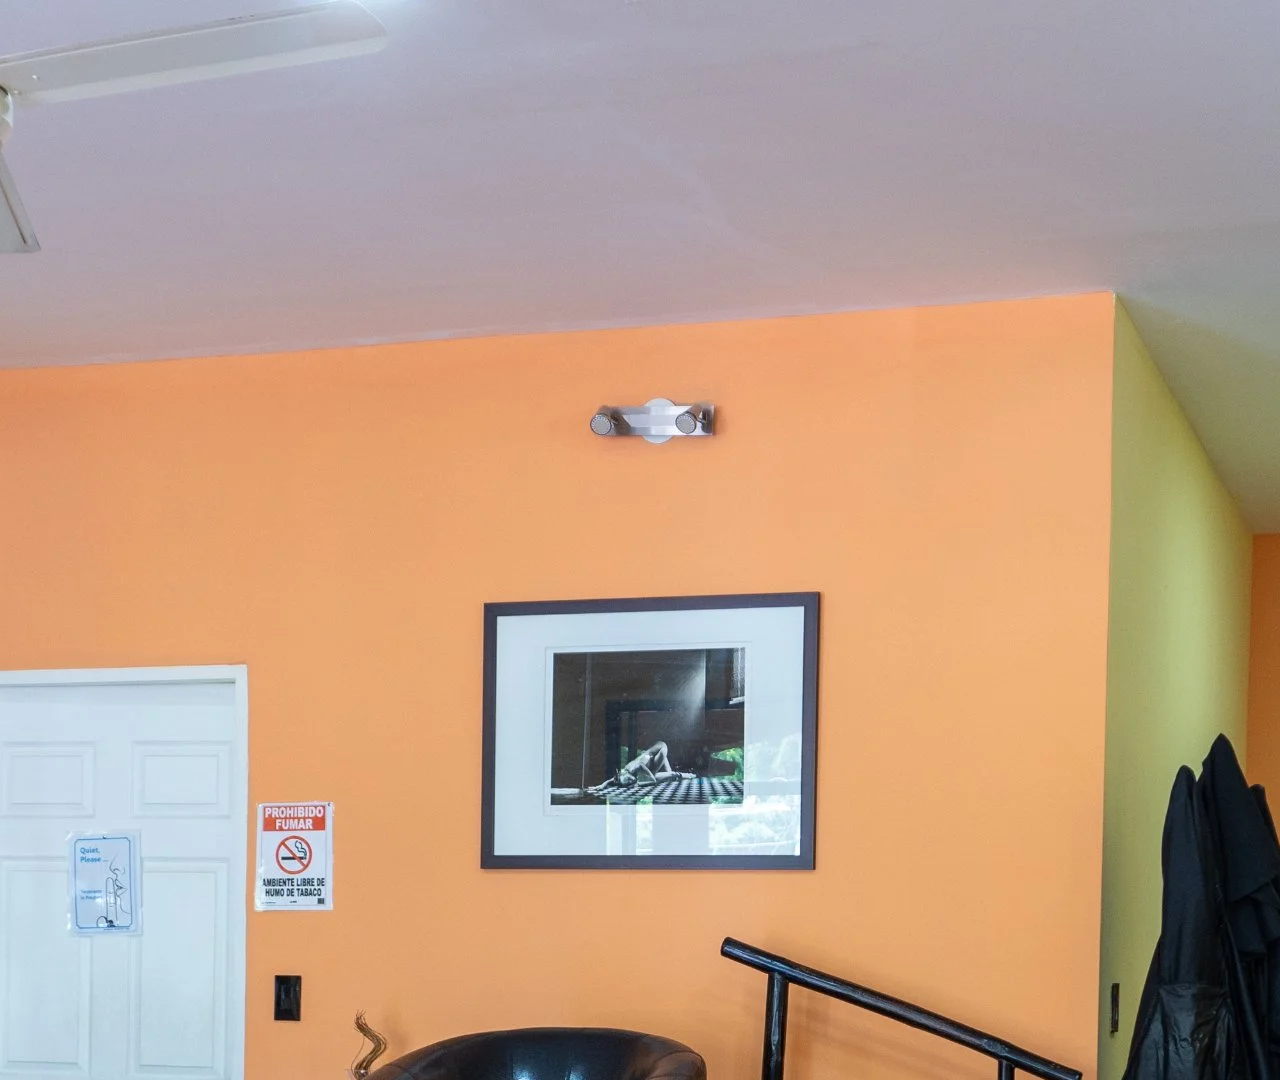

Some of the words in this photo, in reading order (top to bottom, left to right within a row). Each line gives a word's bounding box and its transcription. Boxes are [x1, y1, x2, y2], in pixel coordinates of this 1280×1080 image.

[265, 806, 324, 818] PROHIBIDO
[276, 818, 313, 830] FUMAR
[263, 878, 295, 887] AMBIENTE
[296, 878, 315, 887] LIBRE
[317, 878, 325, 887] DE
[265, 888, 285, 897] HUMO
[286, 888, 295, 897] DE
[297, 888, 322, 897] TABACO
